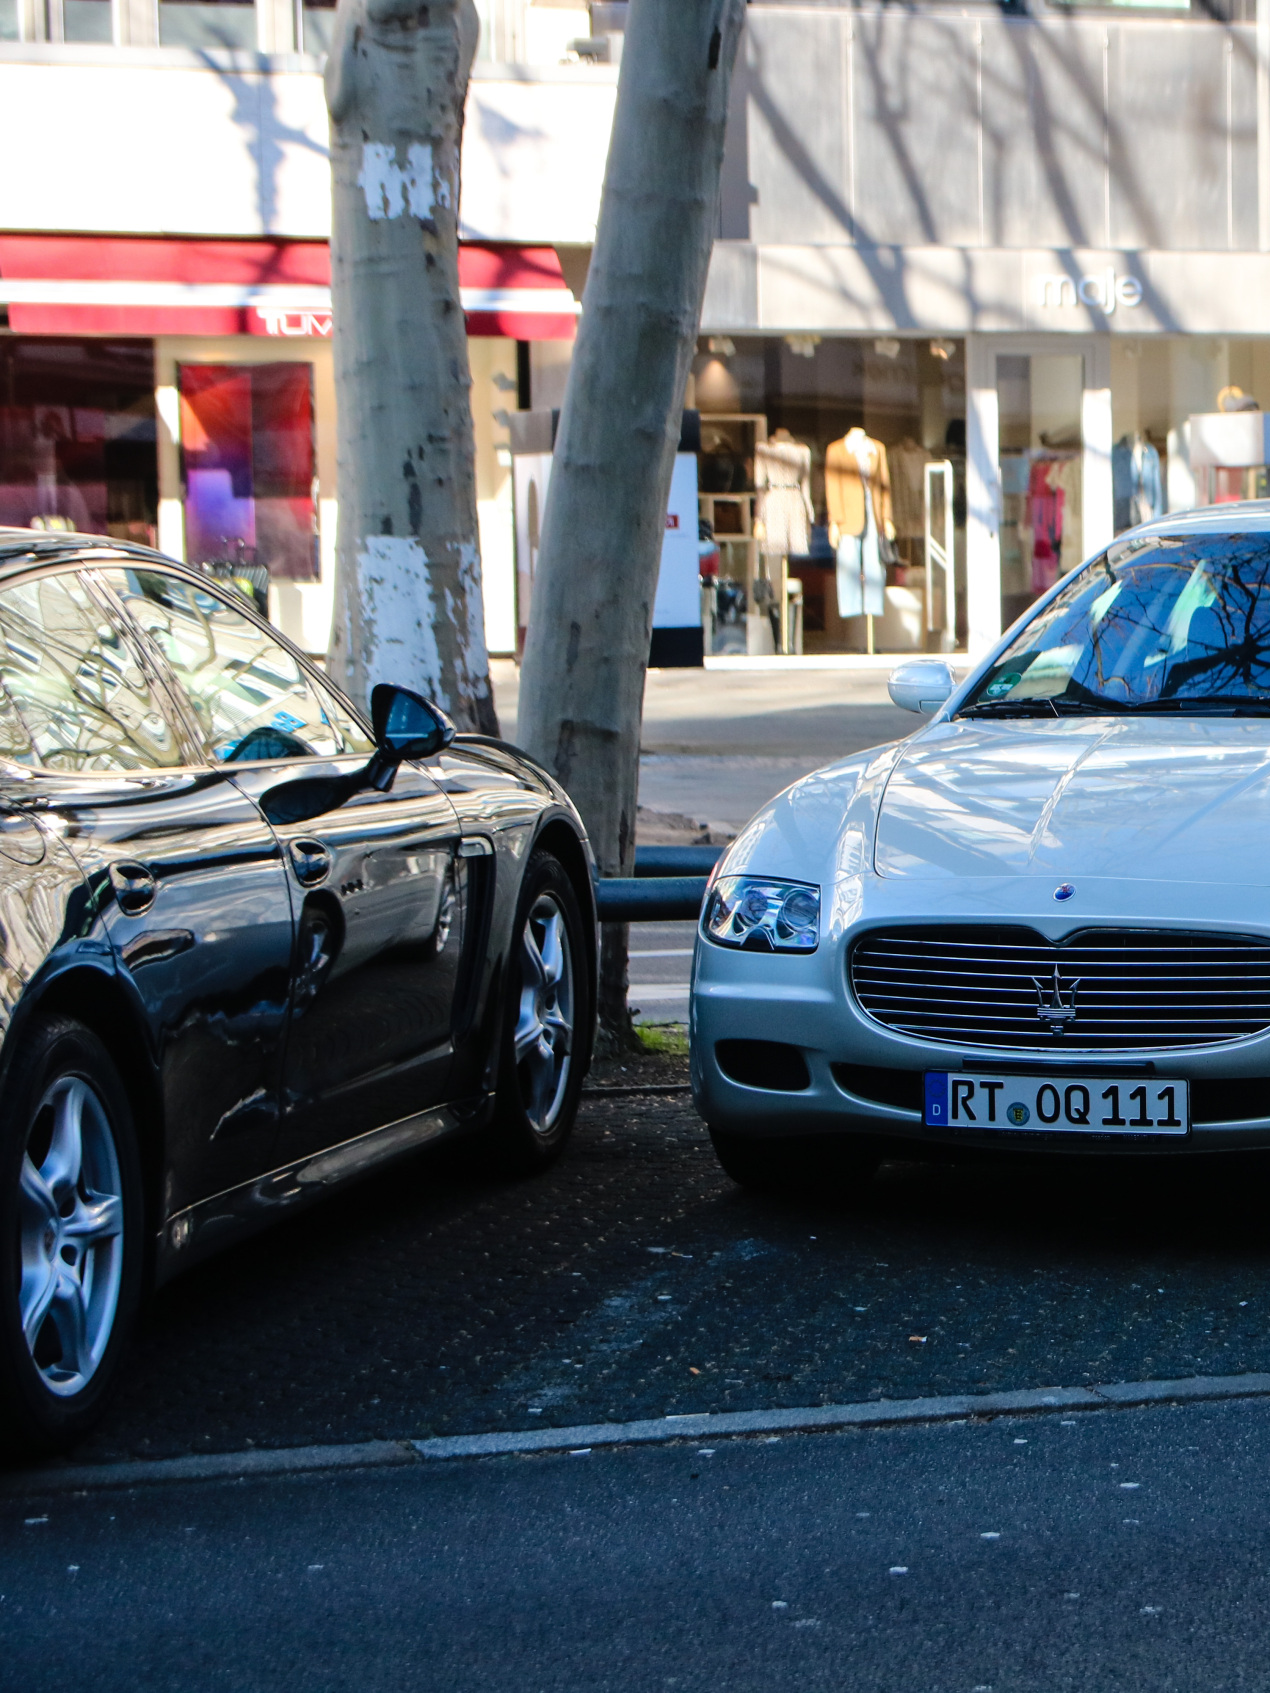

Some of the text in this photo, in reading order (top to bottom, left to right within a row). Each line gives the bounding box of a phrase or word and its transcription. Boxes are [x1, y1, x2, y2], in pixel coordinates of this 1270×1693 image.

[1035, 266, 1143, 314] maje
[932, 1104, 941, 1116] D
[951, 1079, 1004, 1122] RT
[1101, 1085, 1182, 1127] 111
